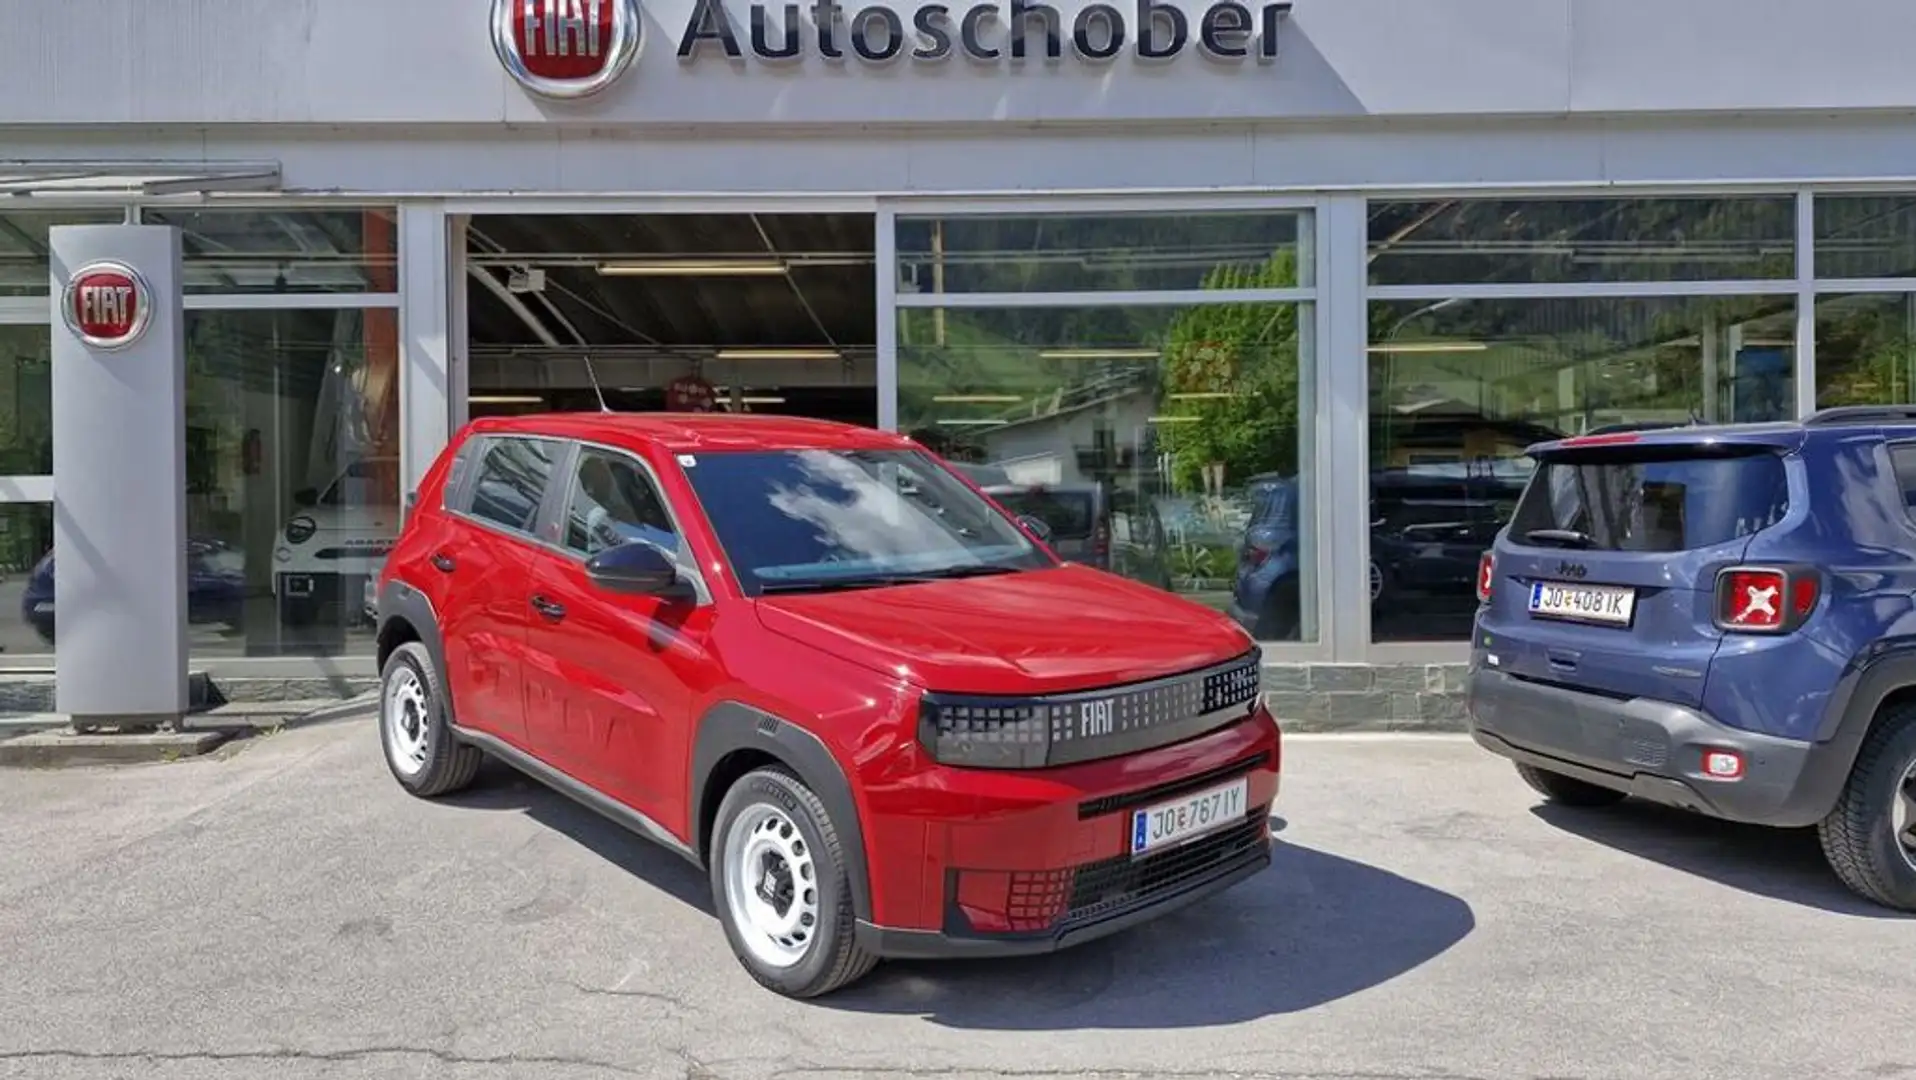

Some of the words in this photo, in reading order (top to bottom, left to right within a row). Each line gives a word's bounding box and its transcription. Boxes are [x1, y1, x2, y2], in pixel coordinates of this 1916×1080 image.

[522, 0, 608, 55] FIAT
[676, 0, 1294, 61] Autoschober
[80, 285, 132, 325] FIAT
[1544, 587, 1563, 608] JO
[1081, 698, 1115, 738] FIAT
[1152, 808, 1175, 840] JO
